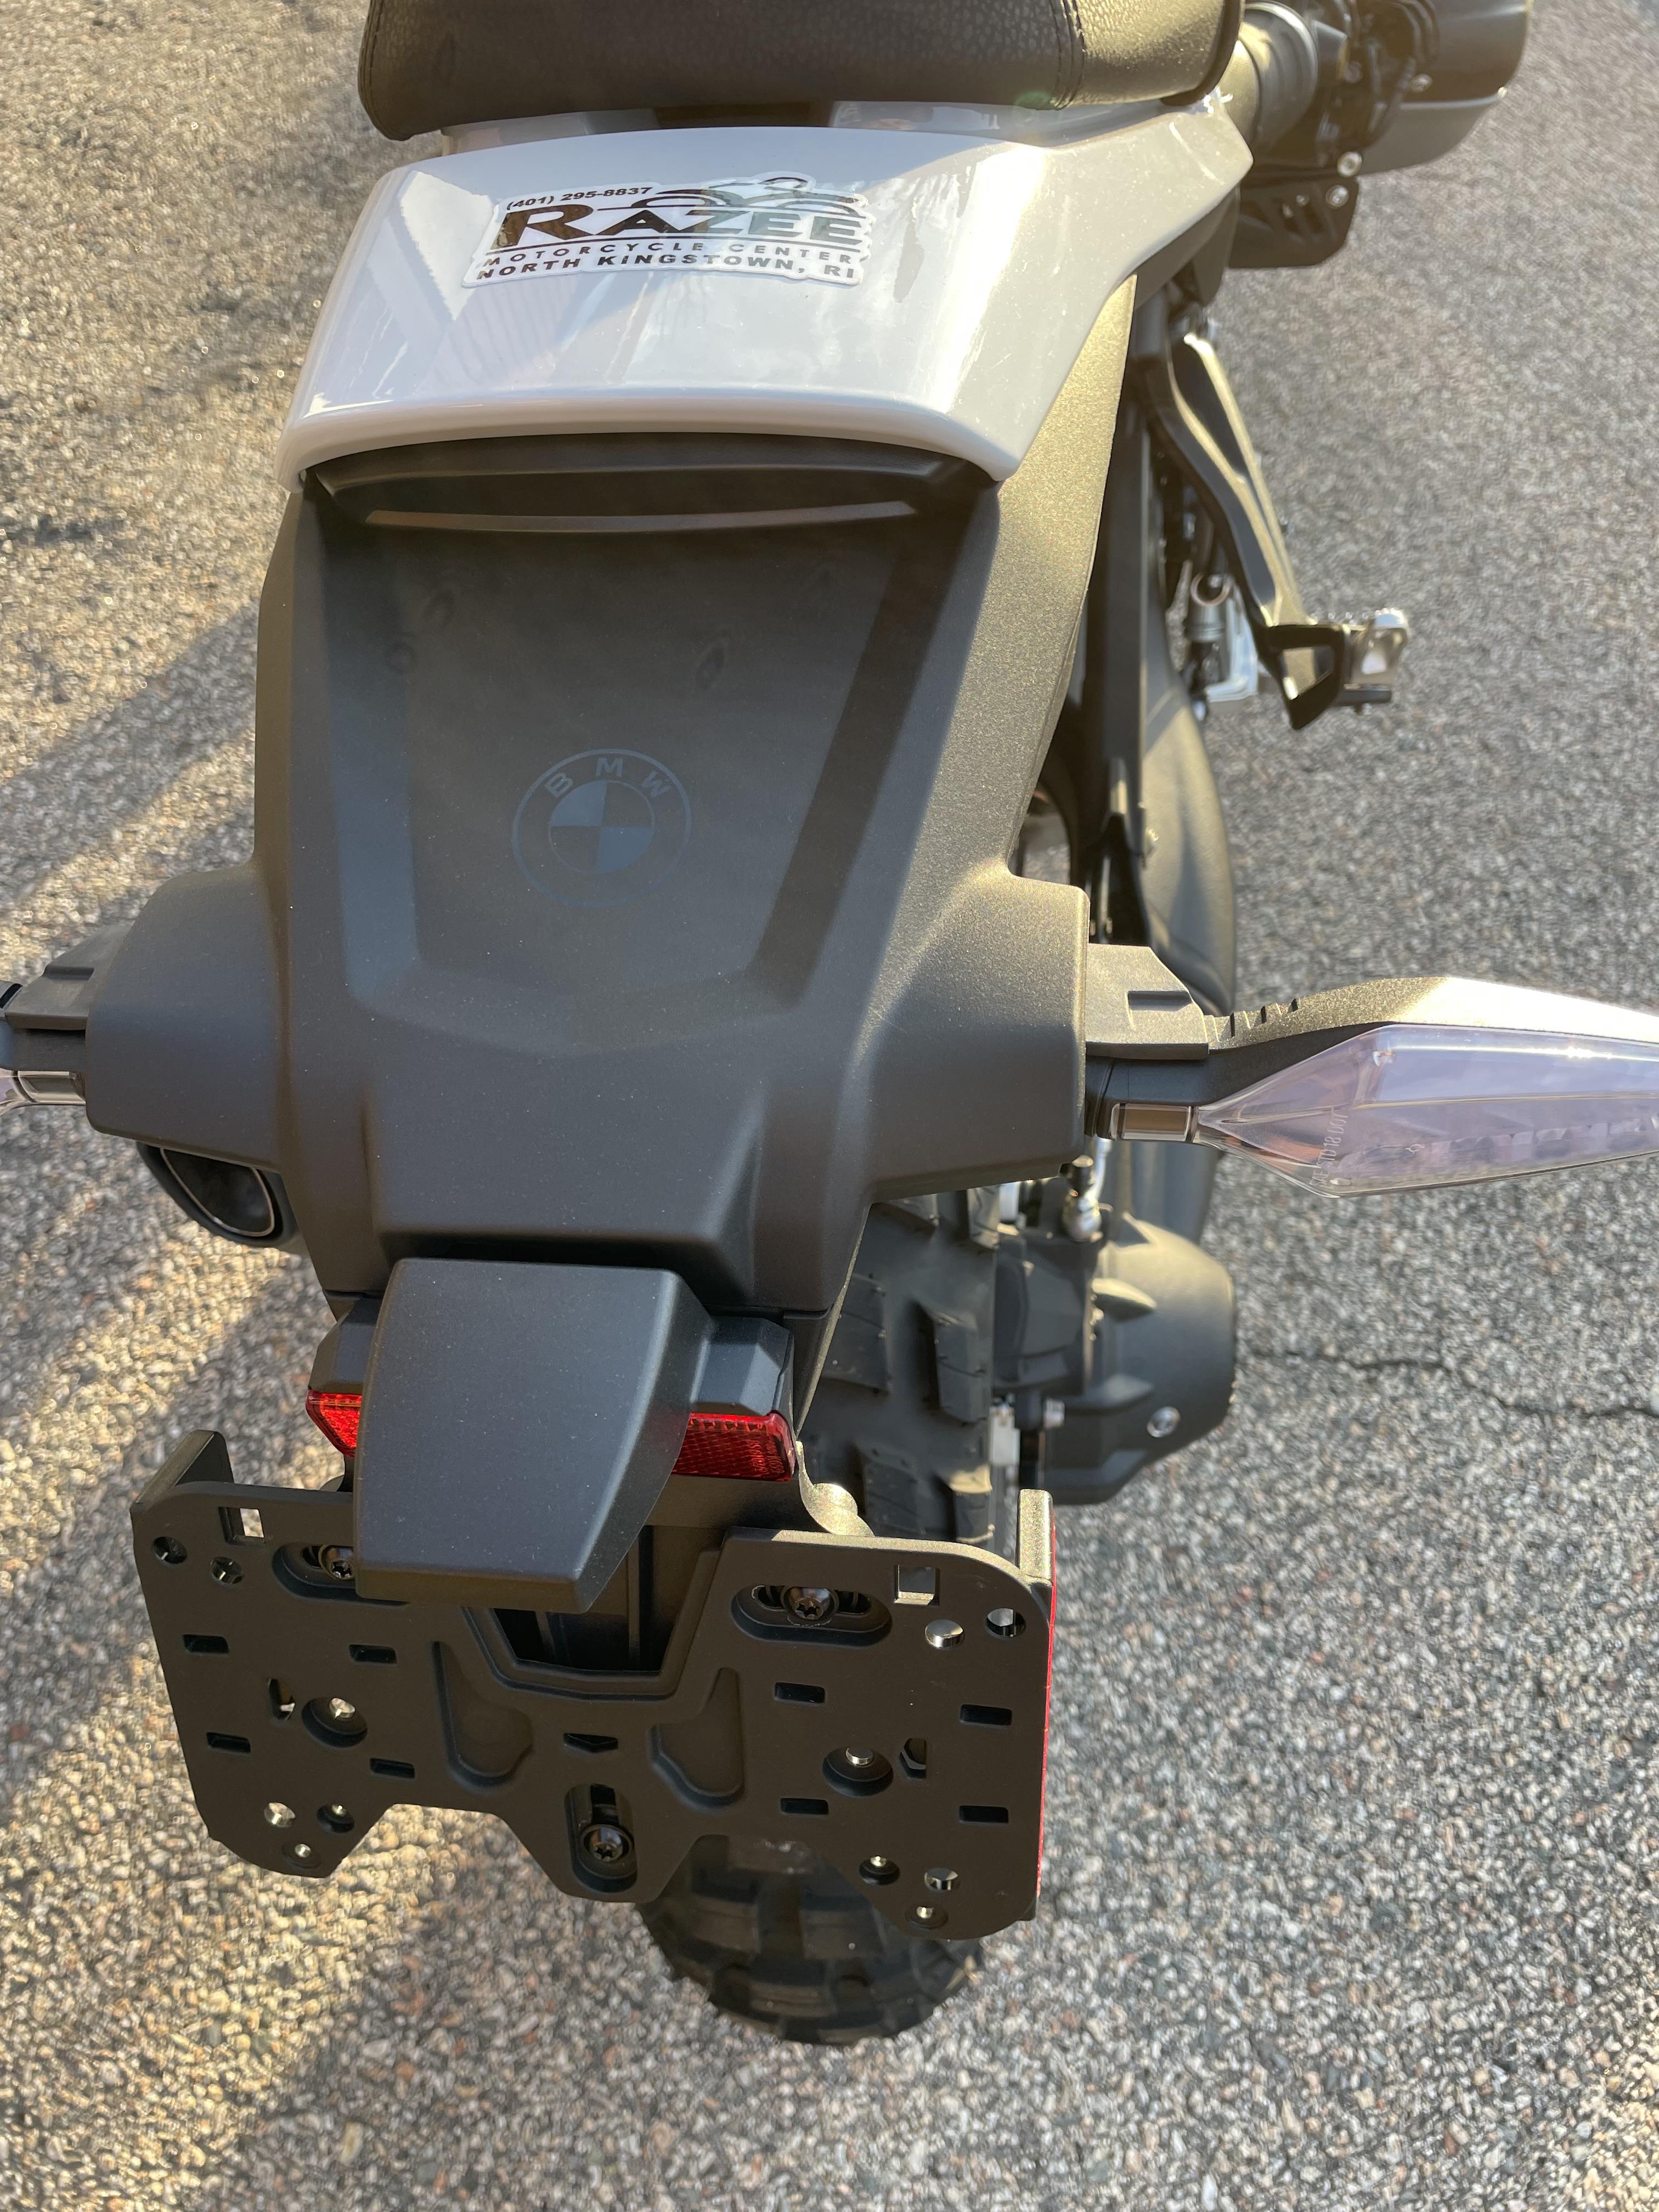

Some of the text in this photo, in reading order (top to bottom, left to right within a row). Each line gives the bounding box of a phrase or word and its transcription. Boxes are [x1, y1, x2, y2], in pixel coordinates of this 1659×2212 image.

[506, 187, 653, 210] (401) 295-8837
[490, 204, 863, 250] RAZEE
[476, 254, 854, 280] NORTH KINGSTOWN, RI
[483, 242, 851, 267] MOTORCYCLE CENTER
[545, 757, 672, 798] BMW
[1327, 1107, 1349, 1134] DOT
